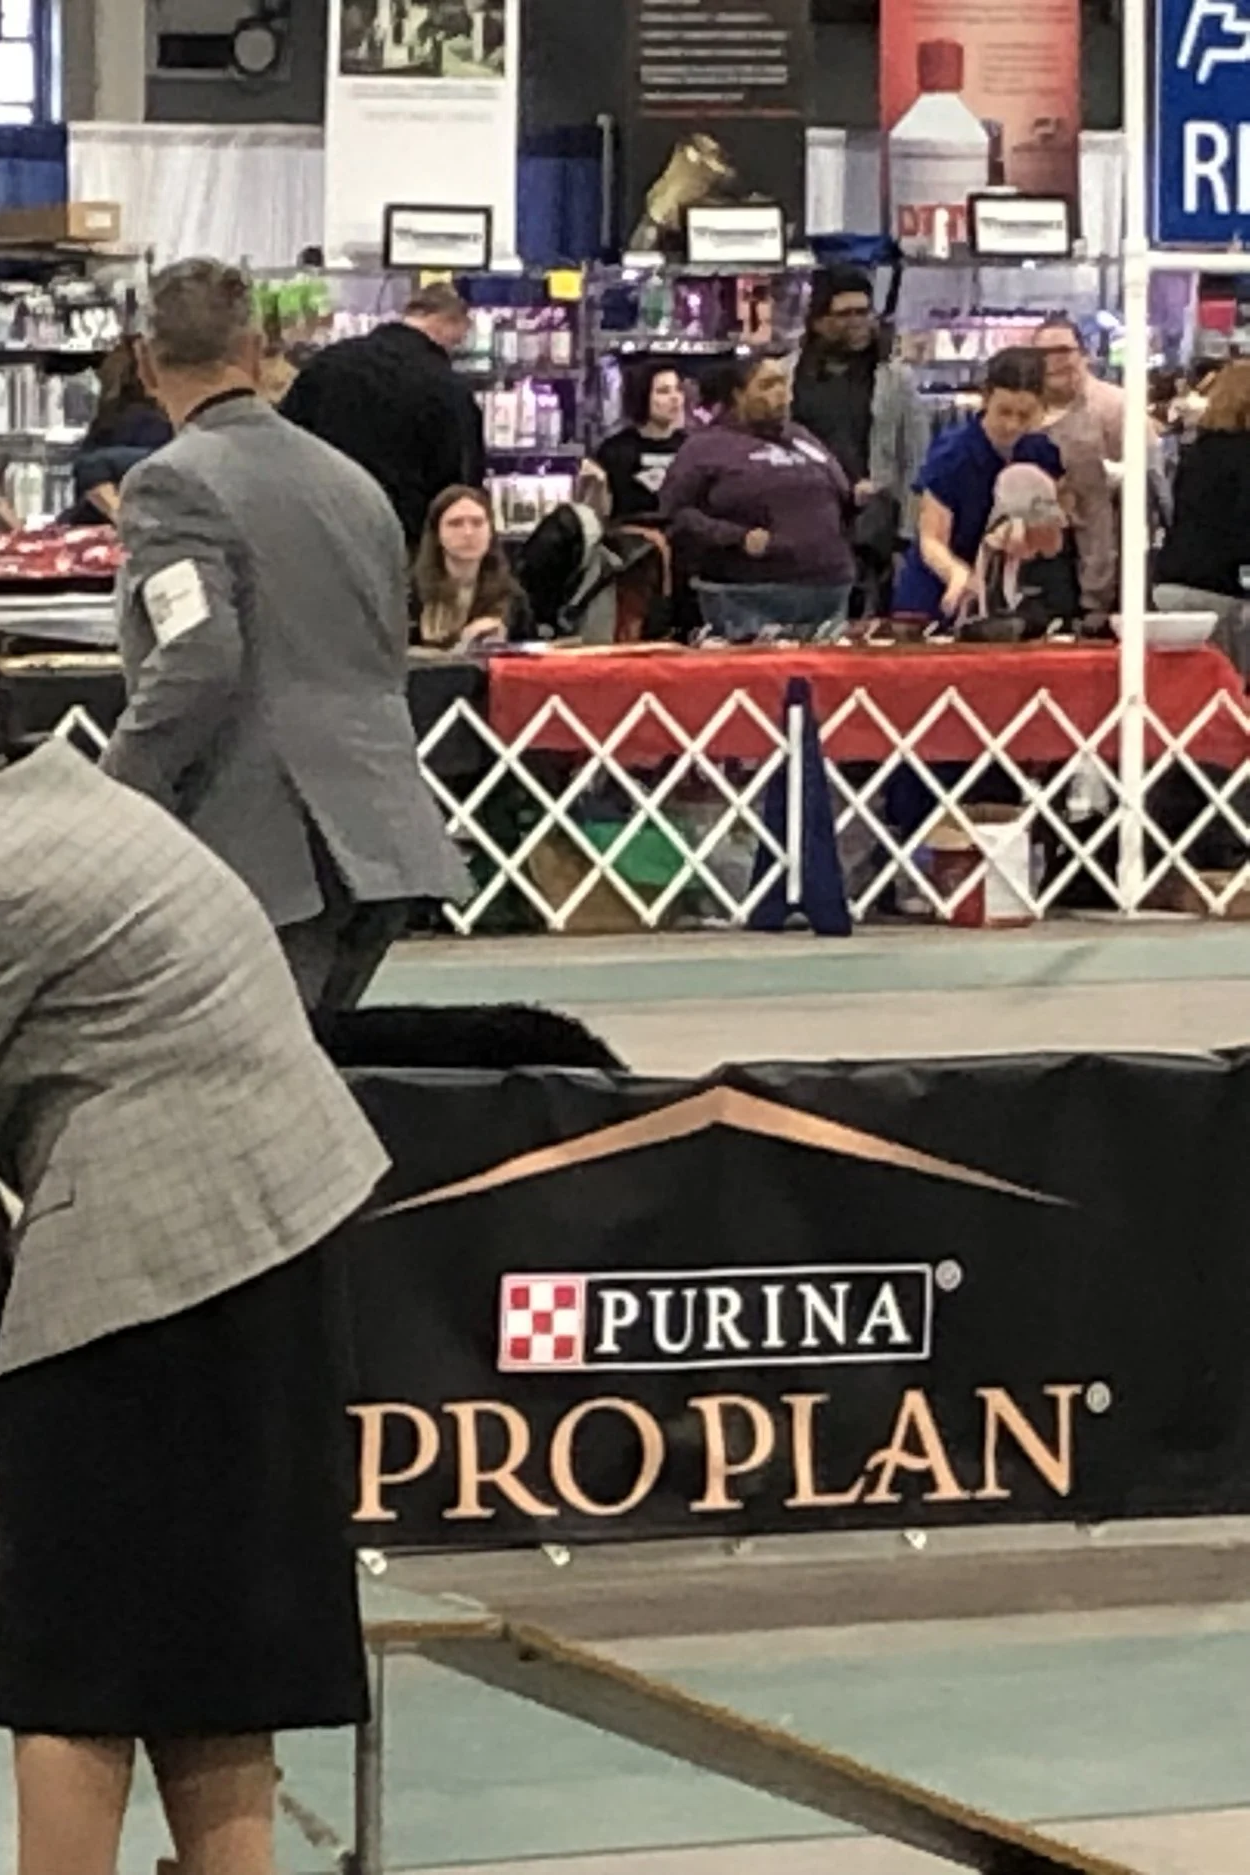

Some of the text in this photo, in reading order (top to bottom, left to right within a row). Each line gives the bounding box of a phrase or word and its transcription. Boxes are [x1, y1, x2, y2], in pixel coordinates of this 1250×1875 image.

[595, 1280, 912, 1354] PURINA
[346, 1383, 1083, 1521] PRO PLAN
